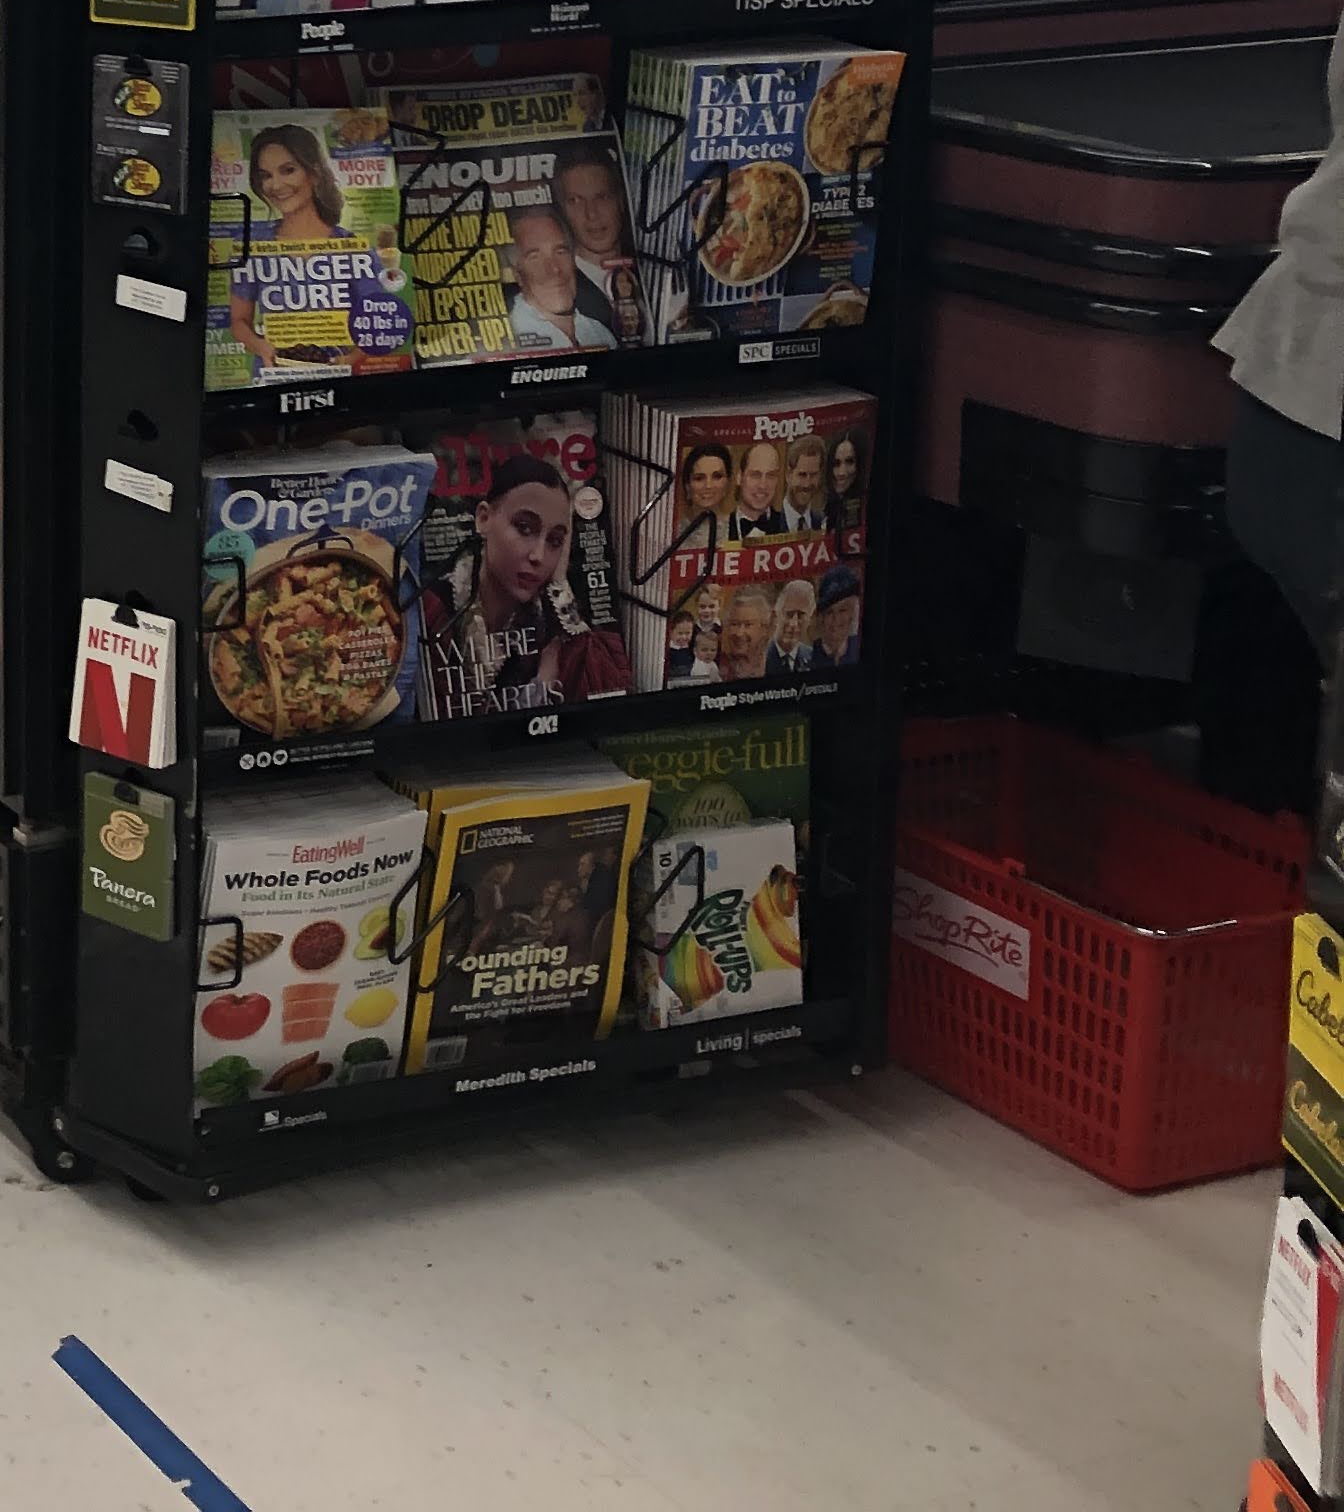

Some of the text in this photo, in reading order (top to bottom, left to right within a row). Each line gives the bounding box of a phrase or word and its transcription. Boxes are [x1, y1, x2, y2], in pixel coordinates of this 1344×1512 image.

[300, 21, 344, 43] People
[700, 72, 796, 107] EAT to
[695, 101, 805, 141] BEAT
[690, 138, 794, 164] diabetes
[338, 159, 386, 172] MORE
[346, 172, 381, 186] JOY!
[812, 196, 875, 213] DIABEES
[823, 188, 852, 200] TYP
[231, 254, 376, 284] HUNGER
[261, 282, 353, 312] CURE
[363, 299, 398, 316] Drop
[433, 282, 507, 322] EPSTEIN
[354, 315, 371, 330] 40
[373, 315, 393, 329] lbs
[395, 314, 408, 328] in
[358, 332, 406, 348] 28 days
[415, 314, 511, 359] COVER-UP!
[741, 343, 769, 362] SPC
[511, 365, 588, 384] ENQUIRER
[280, 390, 335, 413] First
[753, 411, 815, 442] People
[220, 474, 417, 532] One-Pot
[360, 515, 412, 532] Dinners
[673, 531, 861, 579] THE ROYAS
[587, 571, 609, 588] 61
[88, 625, 159, 670] NETFLIX
[435, 627, 538, 665] WHERE
[437, 664, 497, 694] THE
[441, 680, 565, 719] HEART IS
[699, 691, 737, 711] People
[529, 715, 559, 736] OK!
[627, 725, 807, 793] eggie-full
[478, 834, 535, 849] GEOGRAPHIC
[479, 826, 523, 838] NATIONAL
[292, 836, 365, 864] EatingWell
[225, 850, 414, 890] Whole Foods Now
[89, 866, 156, 908] Panera
[242, 890, 276, 902] Food
[279, 889, 293, 901] in
[297, 889, 314, 900] Its
[317, 881, 365, 899] Natural
[105, 895, 141, 912] BREAD
[894, 884, 1025, 969] ShopRite
[471, 962, 600, 999] Fathers
[450, 1000, 499, 1013] America's
[1296, 970, 1344, 1048] Cabe
[696, 1025, 801, 1054] Living specials
[455, 1059, 597, 1093] Meredith Specials
